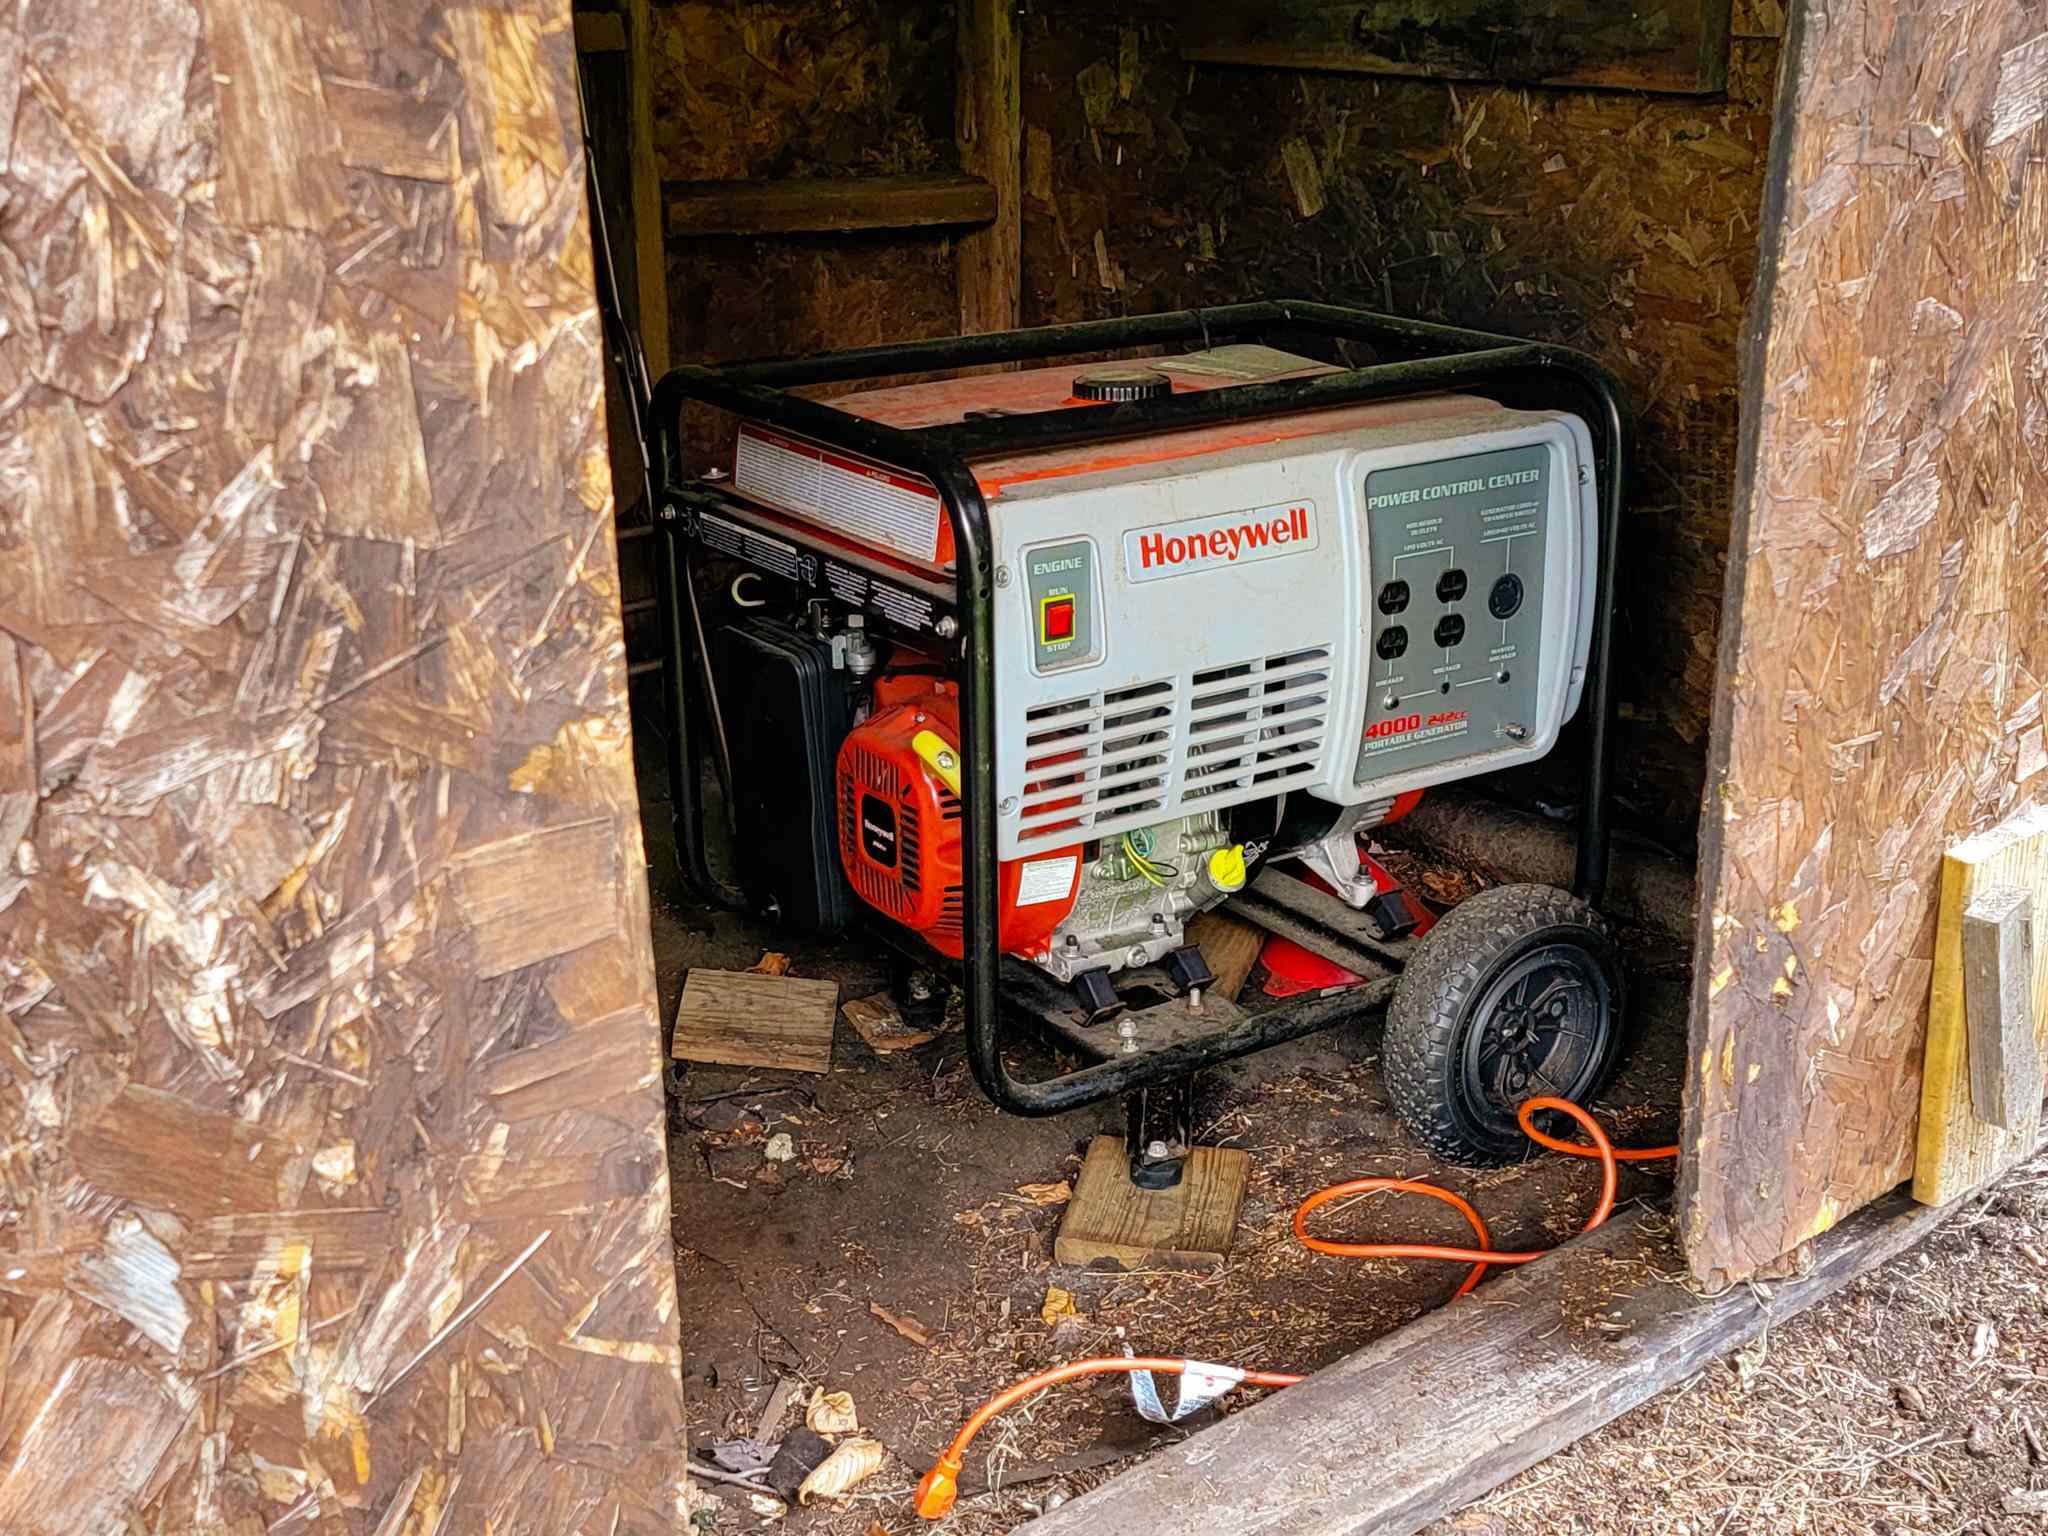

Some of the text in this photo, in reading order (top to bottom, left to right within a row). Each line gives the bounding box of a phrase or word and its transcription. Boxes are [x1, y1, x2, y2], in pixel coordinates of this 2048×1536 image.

[1368, 469, 1540, 510] POWER CONTROL CENTER
[1139, 507, 1309, 569] Honeywell
[1033, 557, 1083, 575] ENGINE
[1046, 642, 1071, 653] STOP
[1364, 732, 1412, 751] PORTABLE
[1413, 720, 1468, 741] GENERATOR
[1365, 714, 1421, 739] 4000
